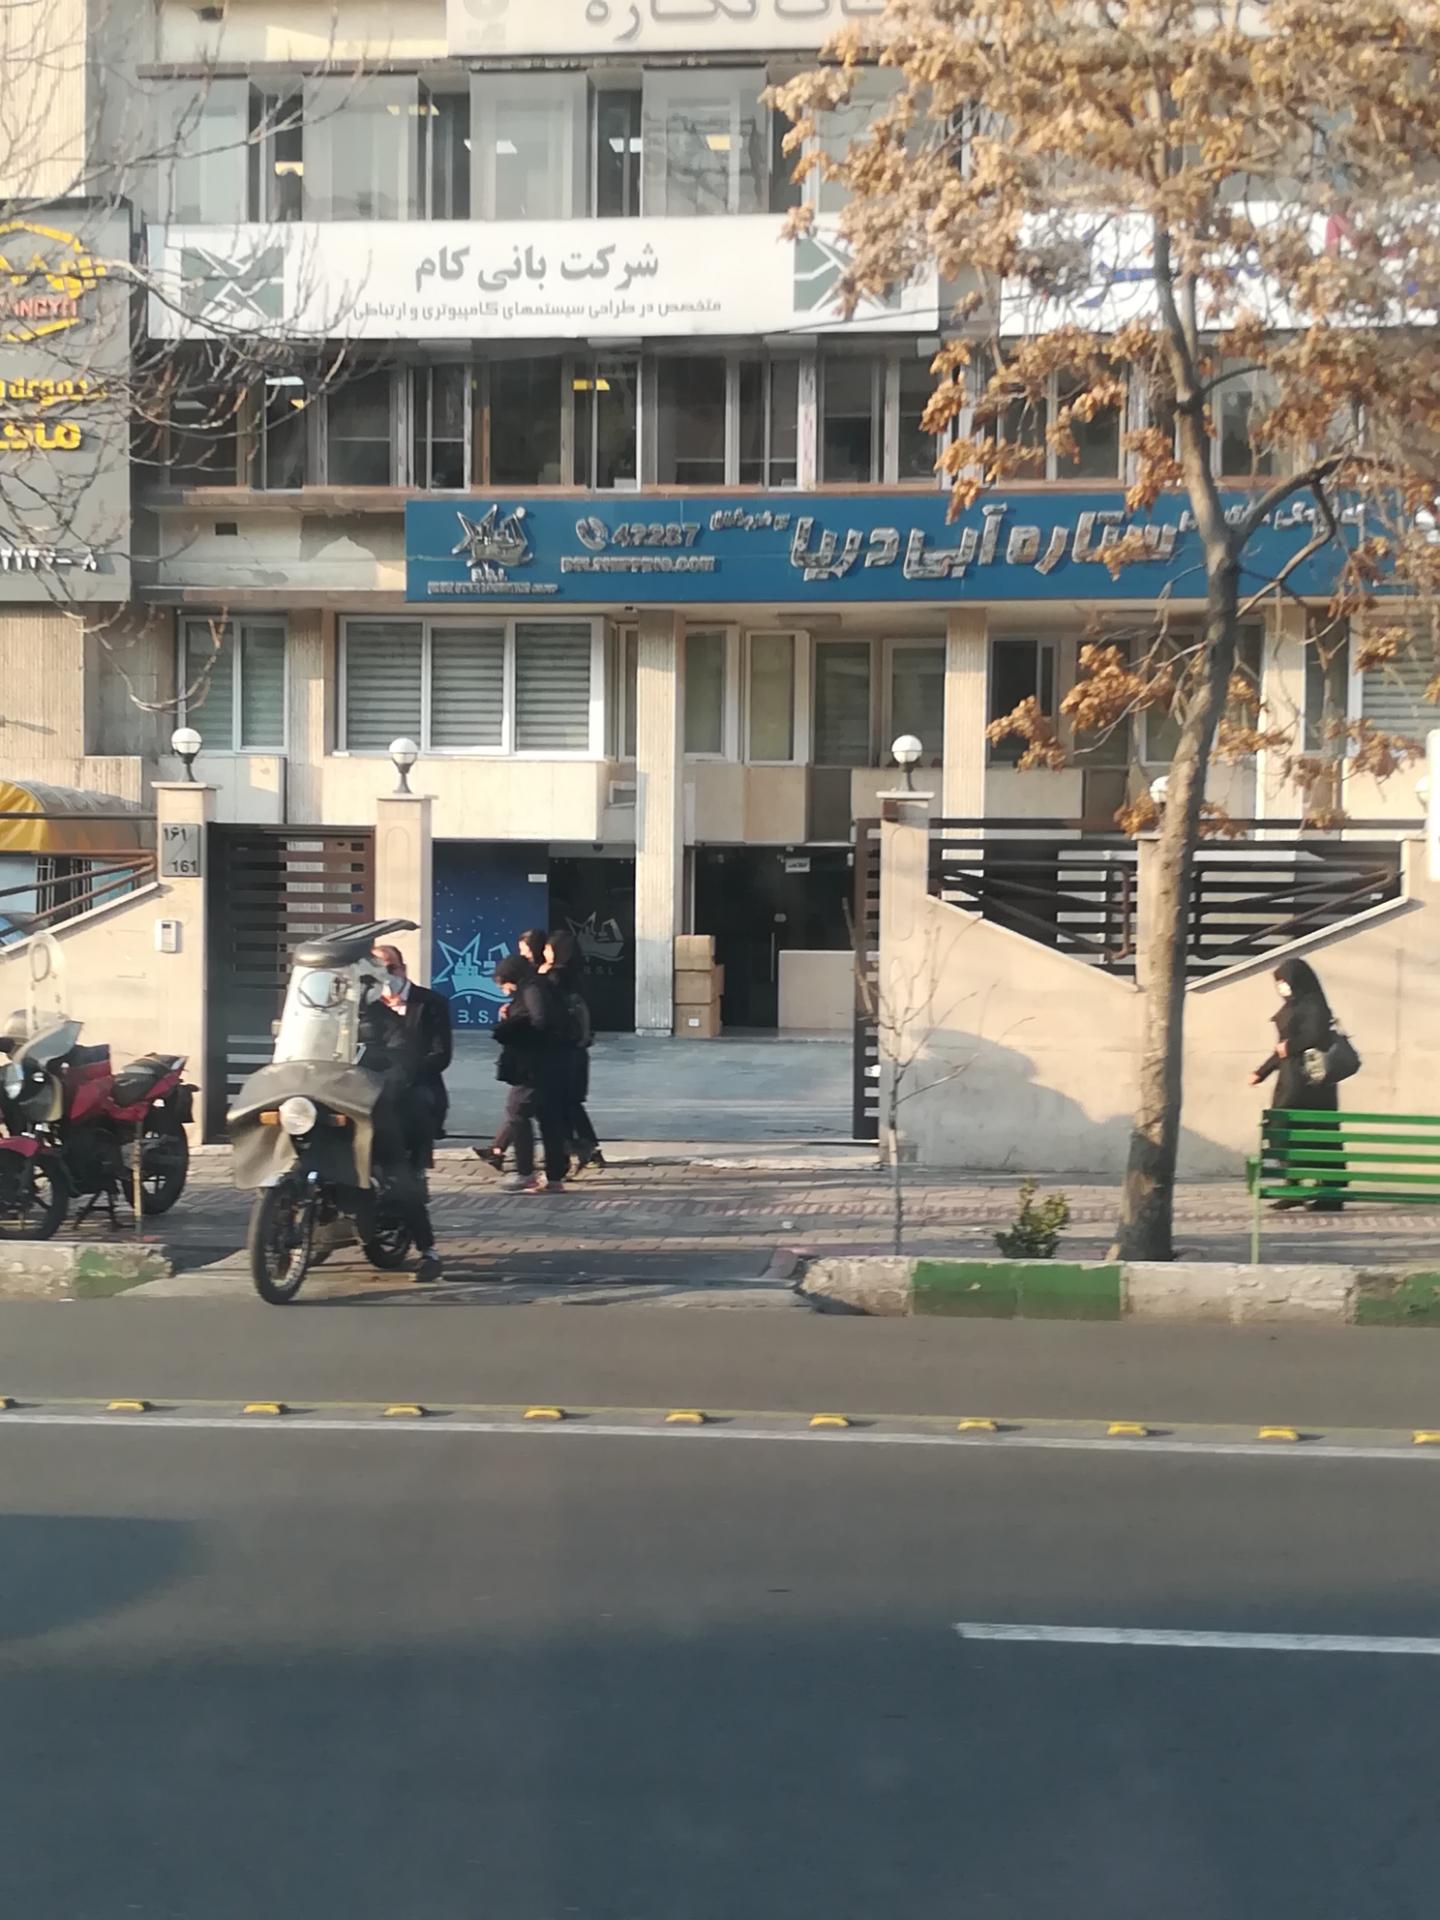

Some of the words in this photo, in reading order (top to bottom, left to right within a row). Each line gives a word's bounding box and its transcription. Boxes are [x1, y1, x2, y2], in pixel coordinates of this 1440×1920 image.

[415, 245, 470, 293] کام
[477, 245, 547, 292] بانی
[560, 243, 659, 290] شرکت
[353, 301, 406, 321] ارتباطی
[409, 305, 418, 321] و
[422, 301, 498, 321] کامپیوتری
[588, 299, 635, 319] طراحی
[639, 302, 654, 318] در
[658, 299, 722, 317] متخصص
[791, 516, 899, 581] دریا
[903, 503, 1008, 580] آبی
[1006, 510, 1177, 576] ستاره
[172, 860, 196, 873] 161
